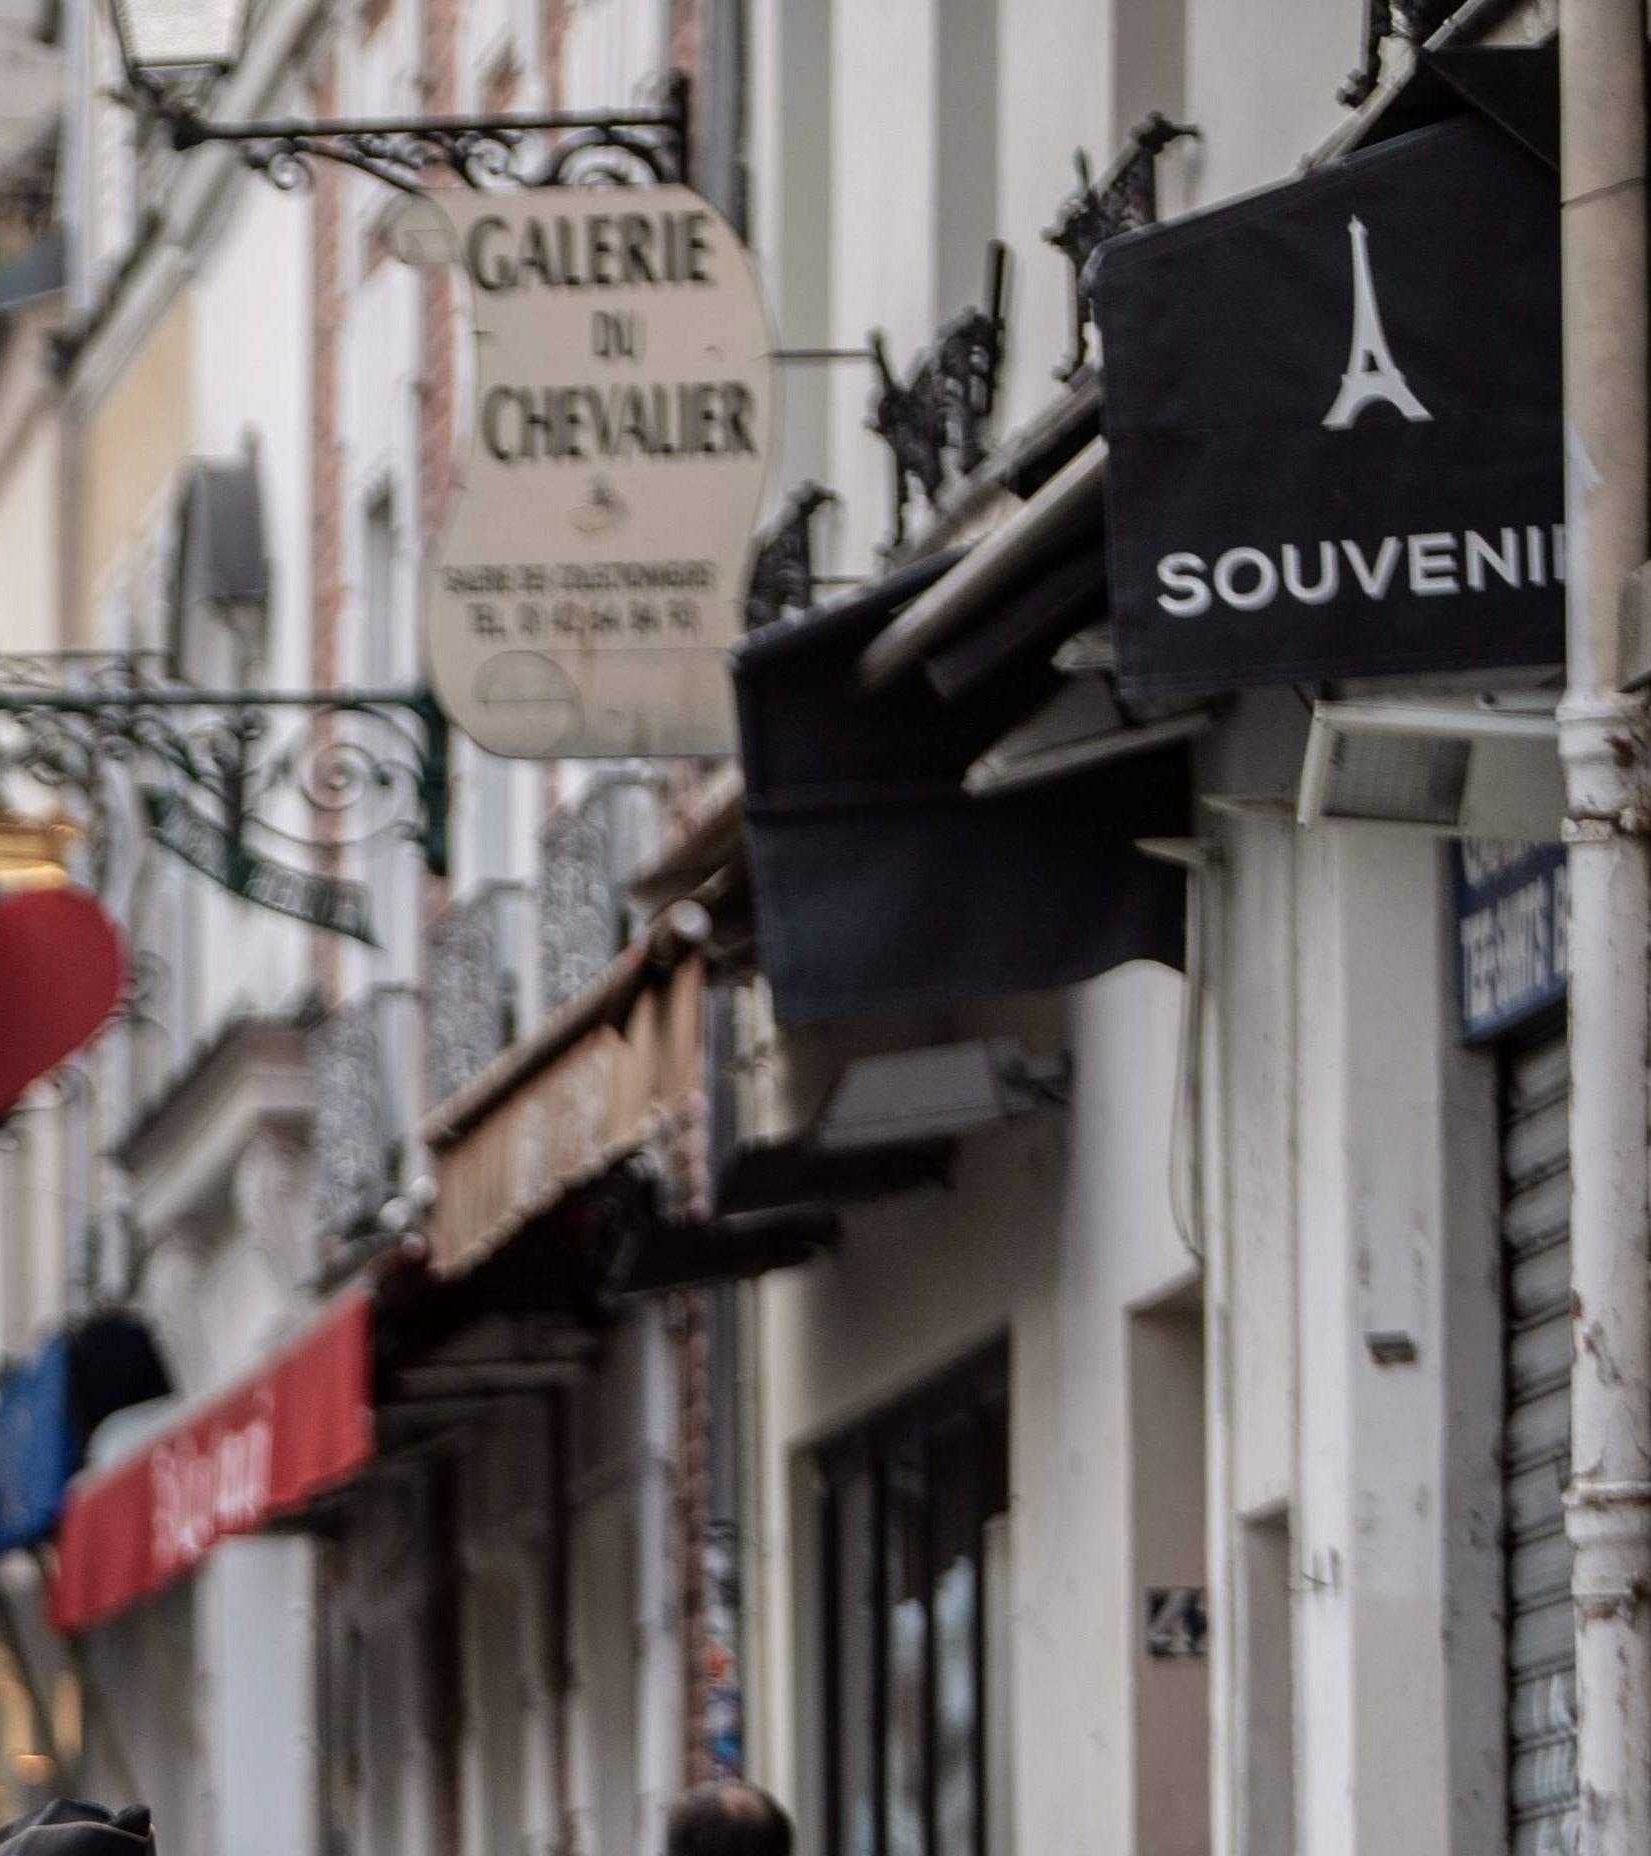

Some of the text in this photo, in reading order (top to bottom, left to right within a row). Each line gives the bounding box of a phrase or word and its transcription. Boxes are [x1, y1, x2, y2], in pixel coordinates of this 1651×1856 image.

[467, 211, 714, 291] GALERIE
[592, 309, 642, 360] DU
[482, 381, 758, 462] CHEVALIER
[1156, 523, 1565, 618] SOUVENI
